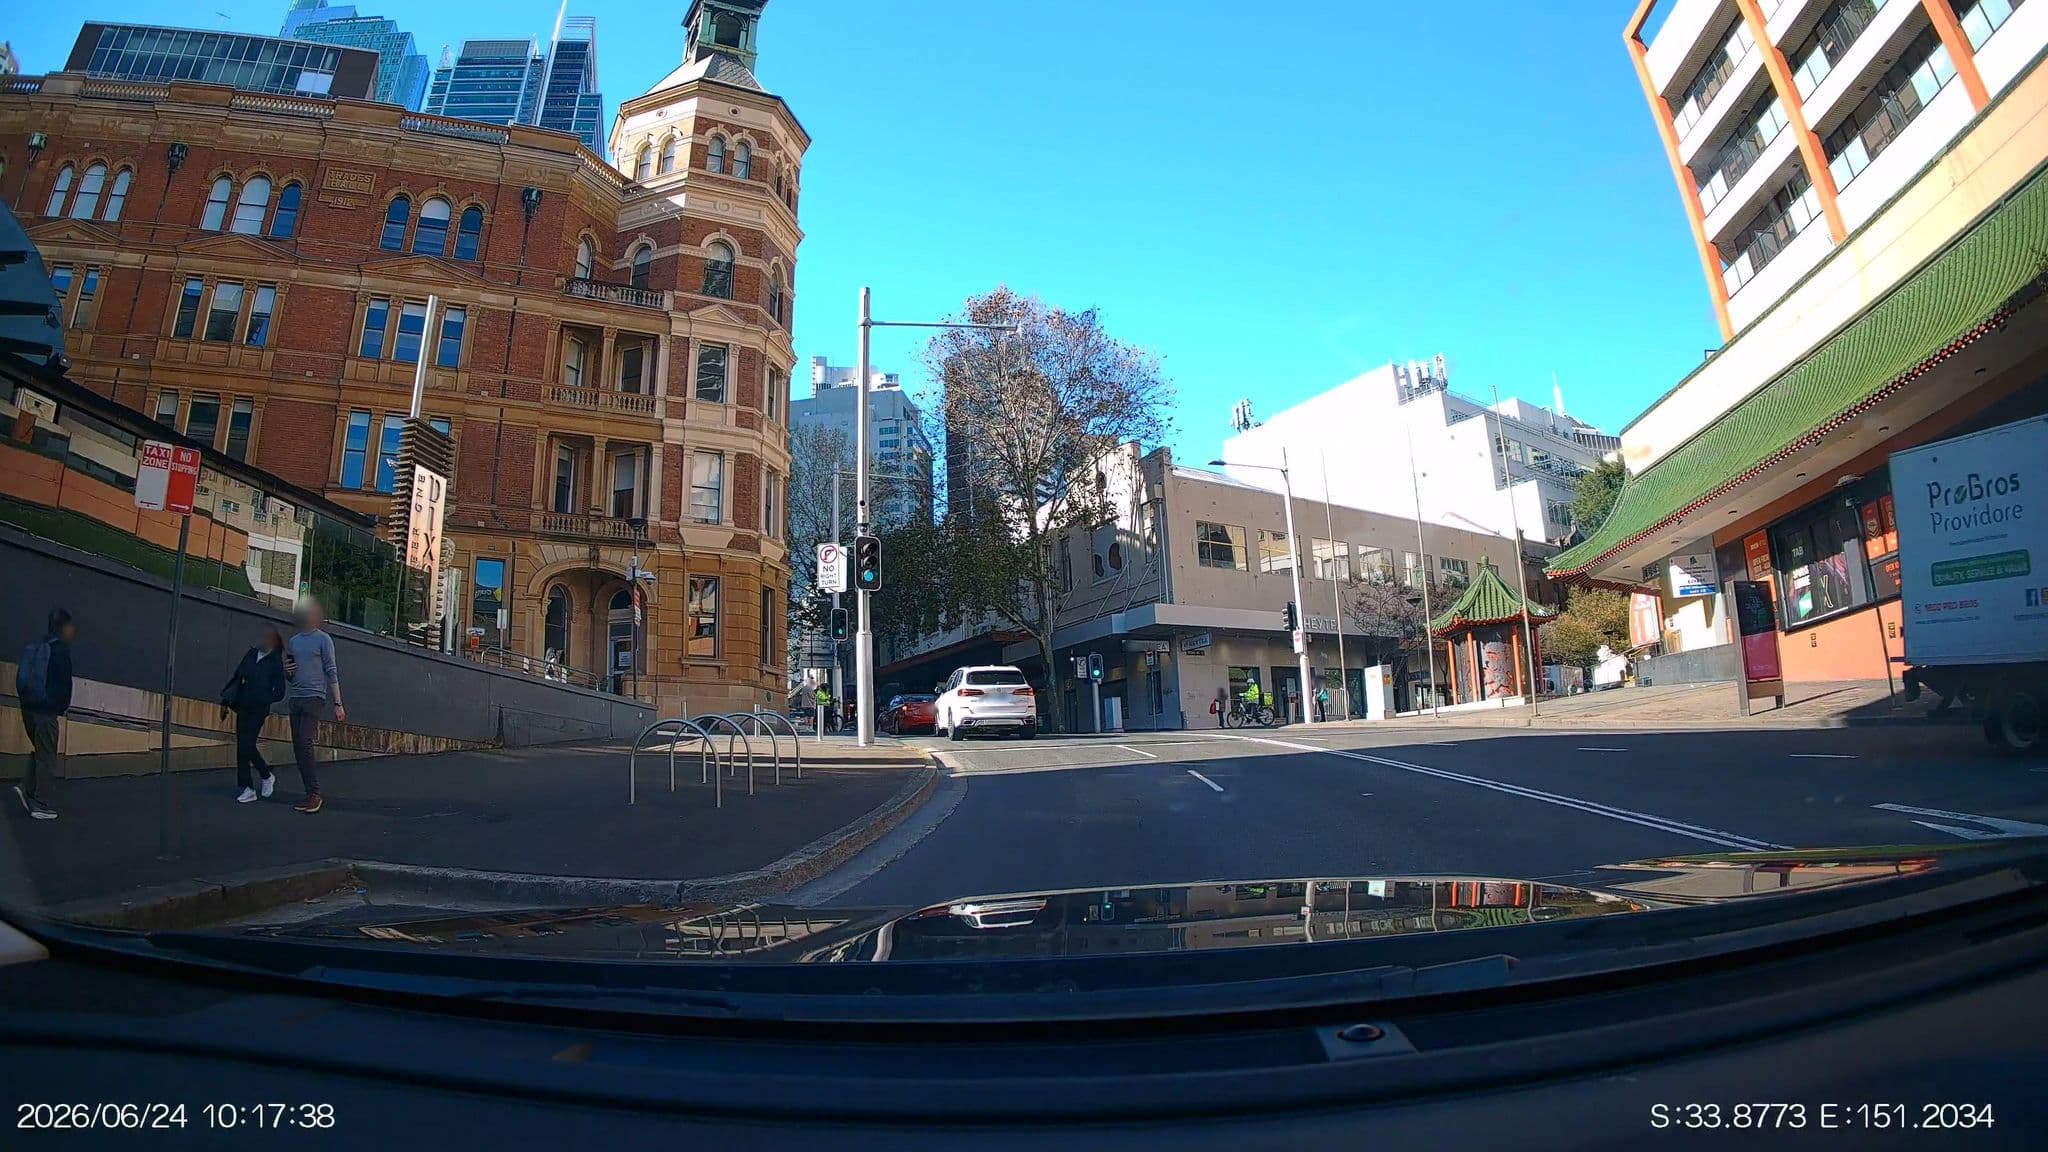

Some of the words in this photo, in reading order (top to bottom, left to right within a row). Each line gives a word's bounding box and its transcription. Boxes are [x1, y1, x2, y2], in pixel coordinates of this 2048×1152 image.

[329, 171, 373, 183] TRADES
[331, 180, 364, 190] HALL
[144, 446, 170, 458] TAXI
[181, 451, 192, 463] NO
[142, 456, 168, 469] ZONE
[171, 463, 197, 475] STOPPING
[1927, 472, 2021, 509] ProBros
[1930, 503, 2024, 535] Providore
[822, 564, 835, 572] NO
[1303, 617, 1340, 630] HEYTE
